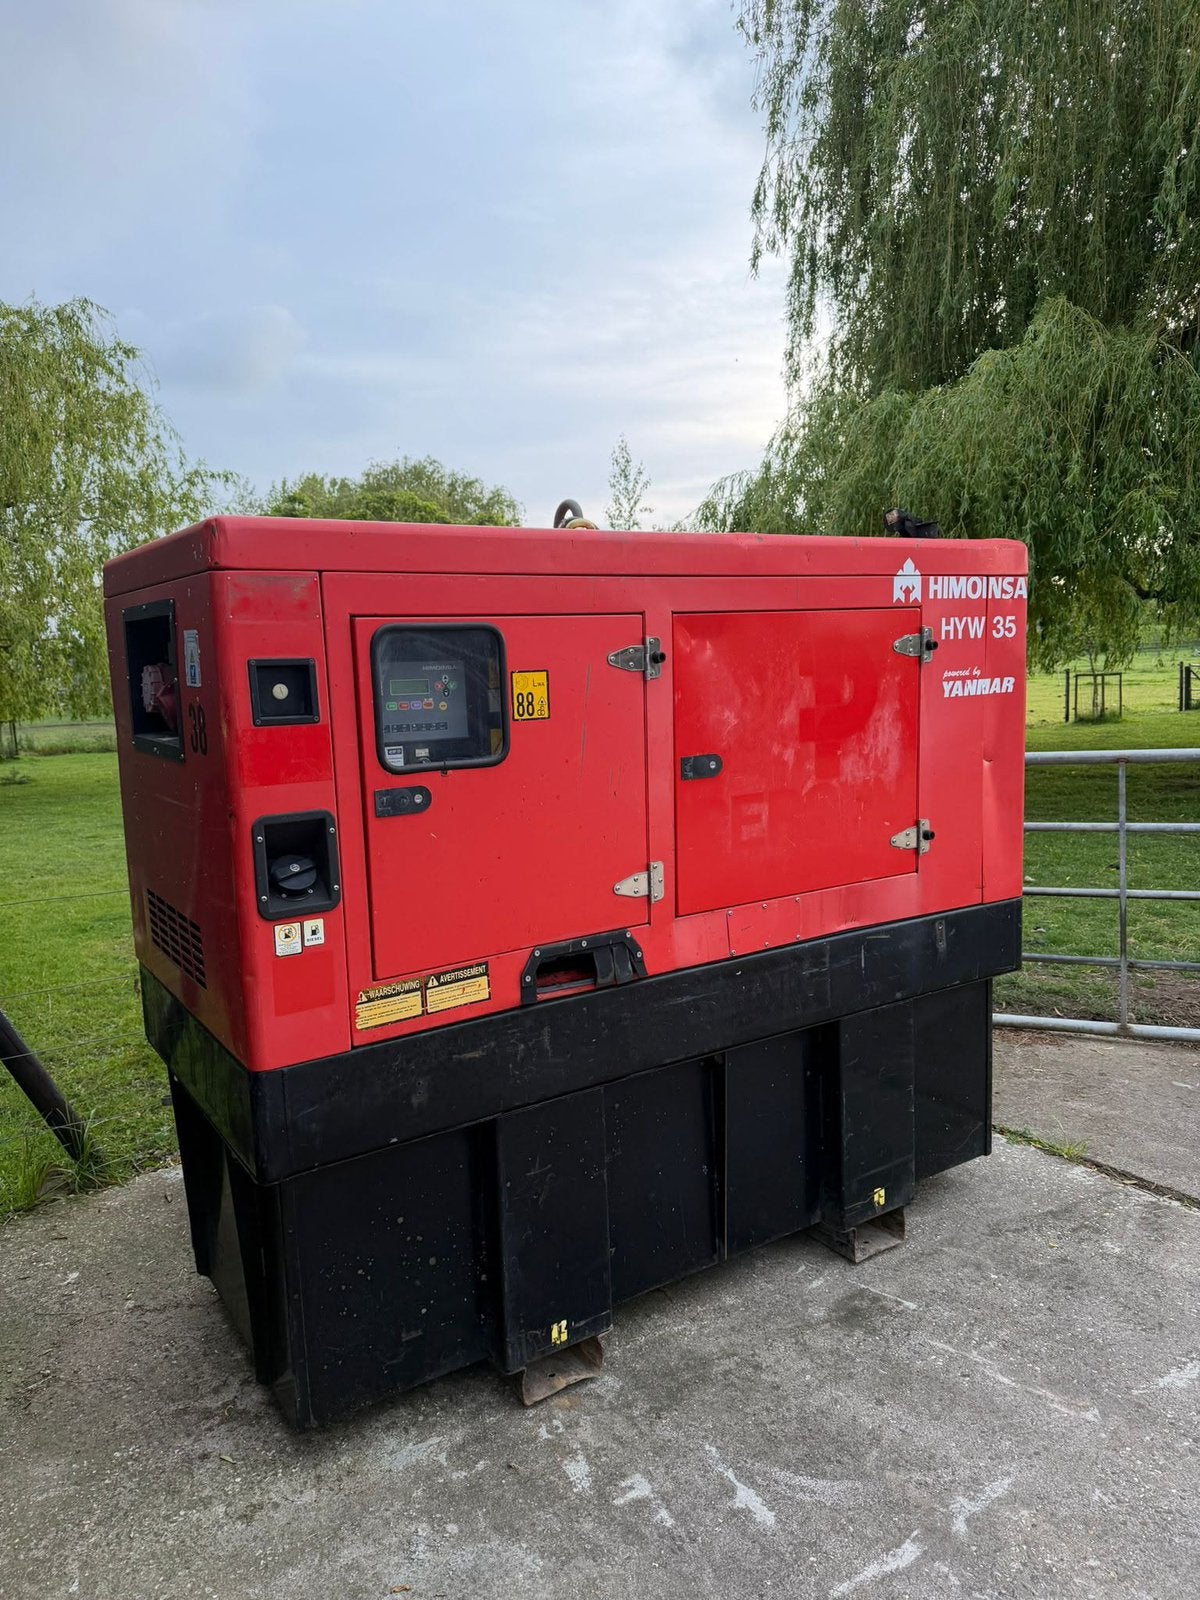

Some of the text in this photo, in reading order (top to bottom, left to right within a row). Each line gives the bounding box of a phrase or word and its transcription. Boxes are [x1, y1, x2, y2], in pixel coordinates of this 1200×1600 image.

[929, 576, 1028, 599] HIMOINSA
[942, 616, 1016, 639] HYW 35
[943, 666, 981, 678] powered by
[943, 677, 1015, 697] YANMAR
[516, 691, 535, 717] 88
[188, 703, 208, 756] 38
[440, 966, 486, 982] AVERTISSEMENT
[369, 981, 419, 997] WAARSCHUWING
